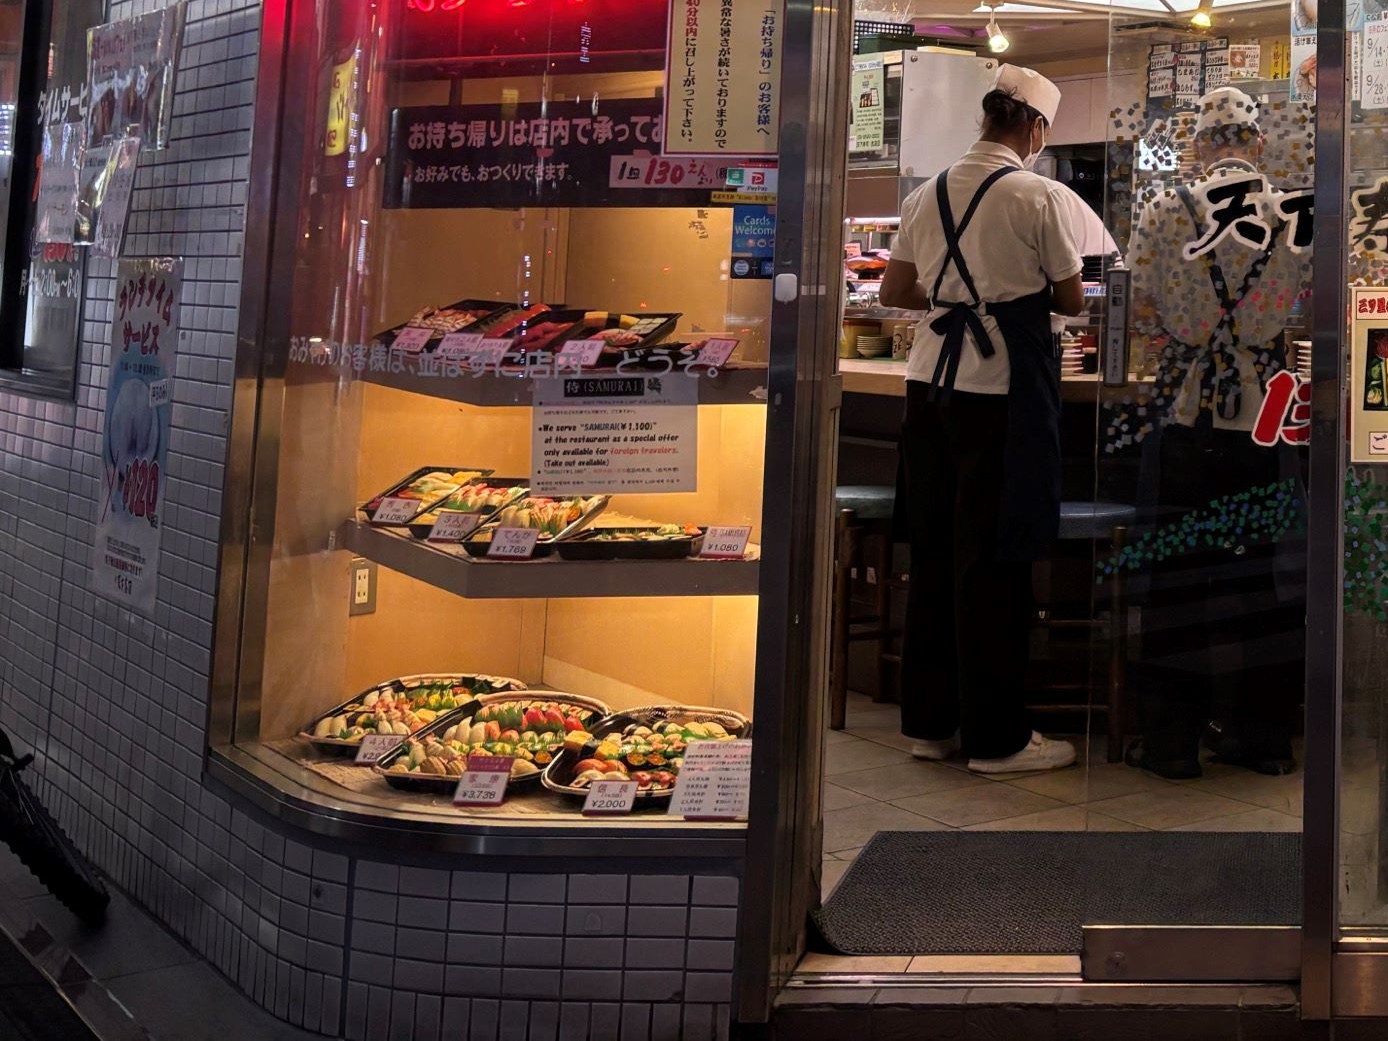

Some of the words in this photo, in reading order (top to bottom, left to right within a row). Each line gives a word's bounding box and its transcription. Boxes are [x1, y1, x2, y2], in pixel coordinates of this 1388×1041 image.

[757, 9, 776, 136] 「お持ち帰り」のお客様へ
[743, 215, 771, 226] Cards
[555, 435, 567, 444] the
[569, 435, 610, 444] restaurant
[630, 434, 656, 443] special
[658, 433, 679, 442] offer
[544, 448, 560, 457] only
[562, 447, 593, 456] available
[596, 447, 609, 456] for
